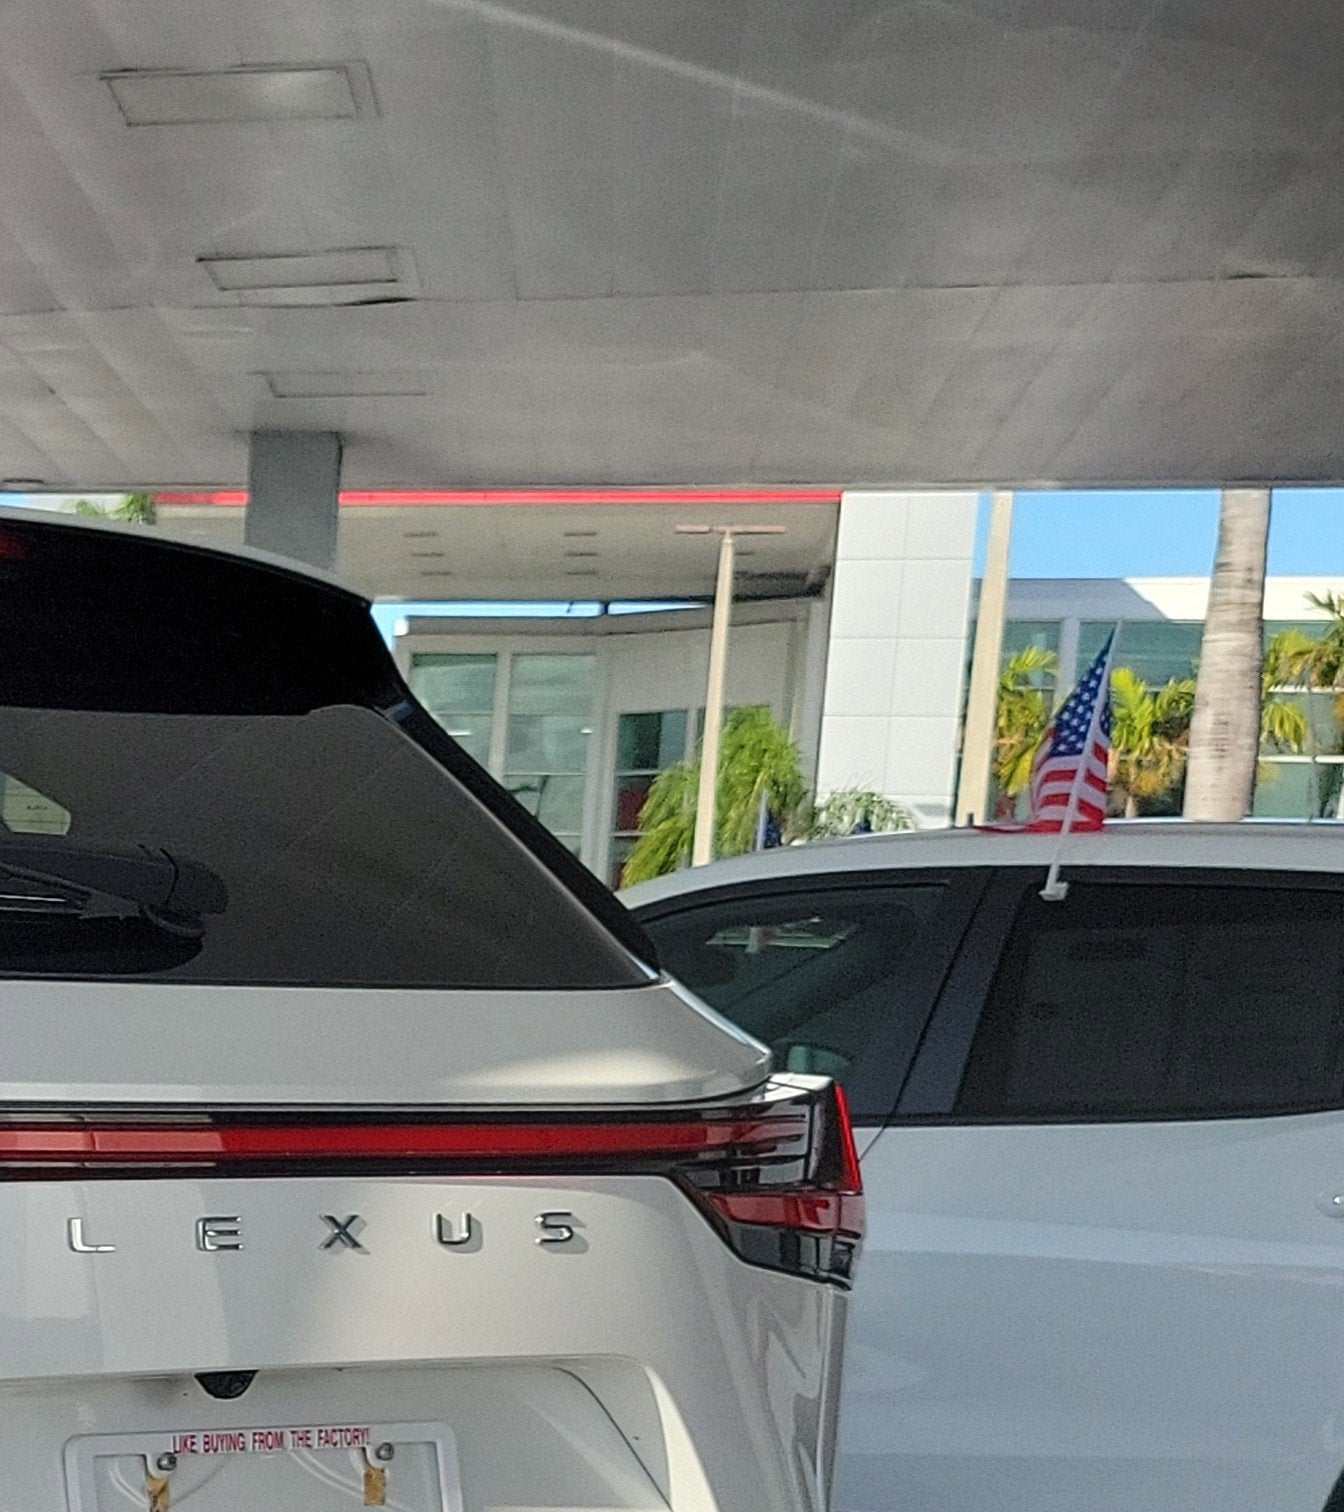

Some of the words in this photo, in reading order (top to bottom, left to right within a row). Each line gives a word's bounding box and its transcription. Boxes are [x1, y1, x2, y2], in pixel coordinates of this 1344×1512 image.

[66, 1212, 575, 1254] LEXUS
[173, 1433, 198, 1454] LIKE
[202, 1432, 246, 1453] BUYING
[251, 1430, 285, 1451] FROM
[290, 1429, 313, 1449] THE
[316, 1426, 371, 1449] FACTORY!
